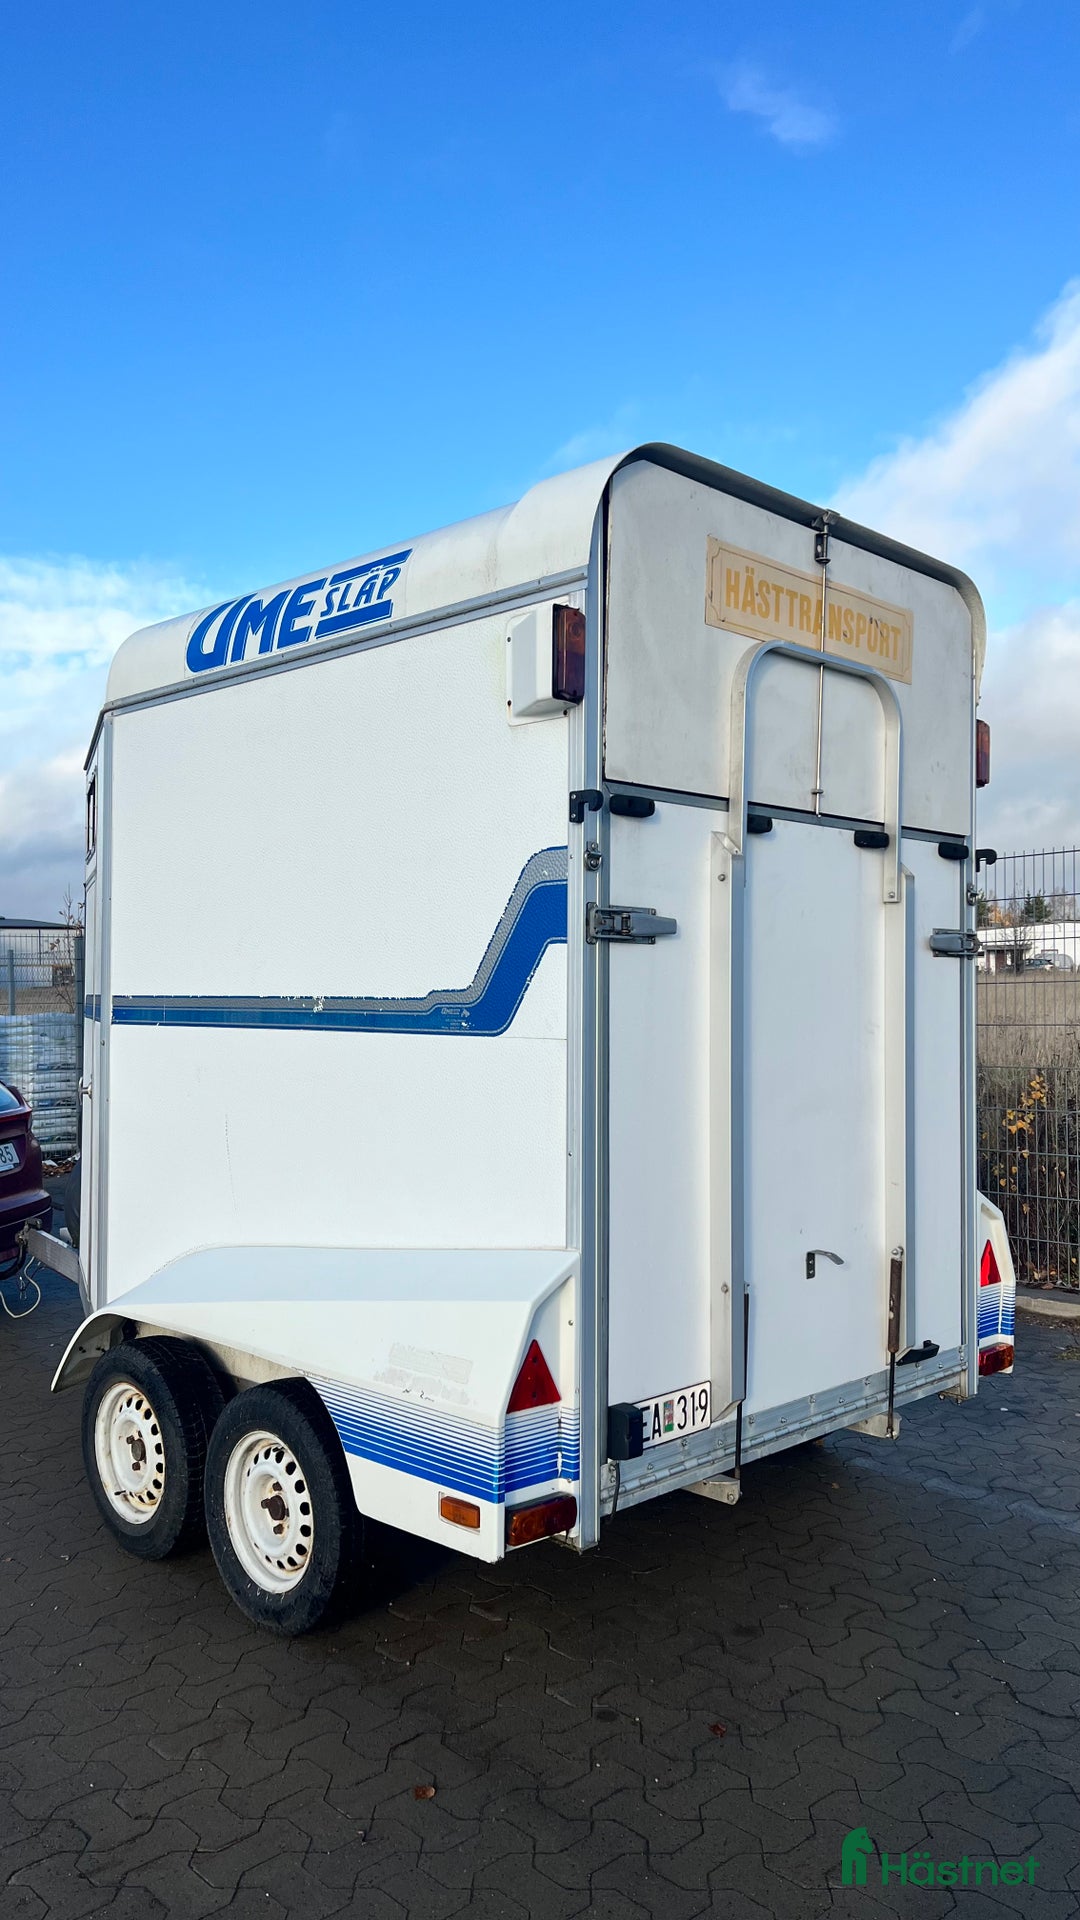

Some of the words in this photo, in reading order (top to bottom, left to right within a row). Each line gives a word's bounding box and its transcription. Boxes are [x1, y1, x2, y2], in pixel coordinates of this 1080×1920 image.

[186, 576, 328, 673] UME
[320, 564, 401, 618] SLÄP
[725, 565, 901, 661] HÄSTTRANSPORT
[677, 1388, 708, 1430] 319
